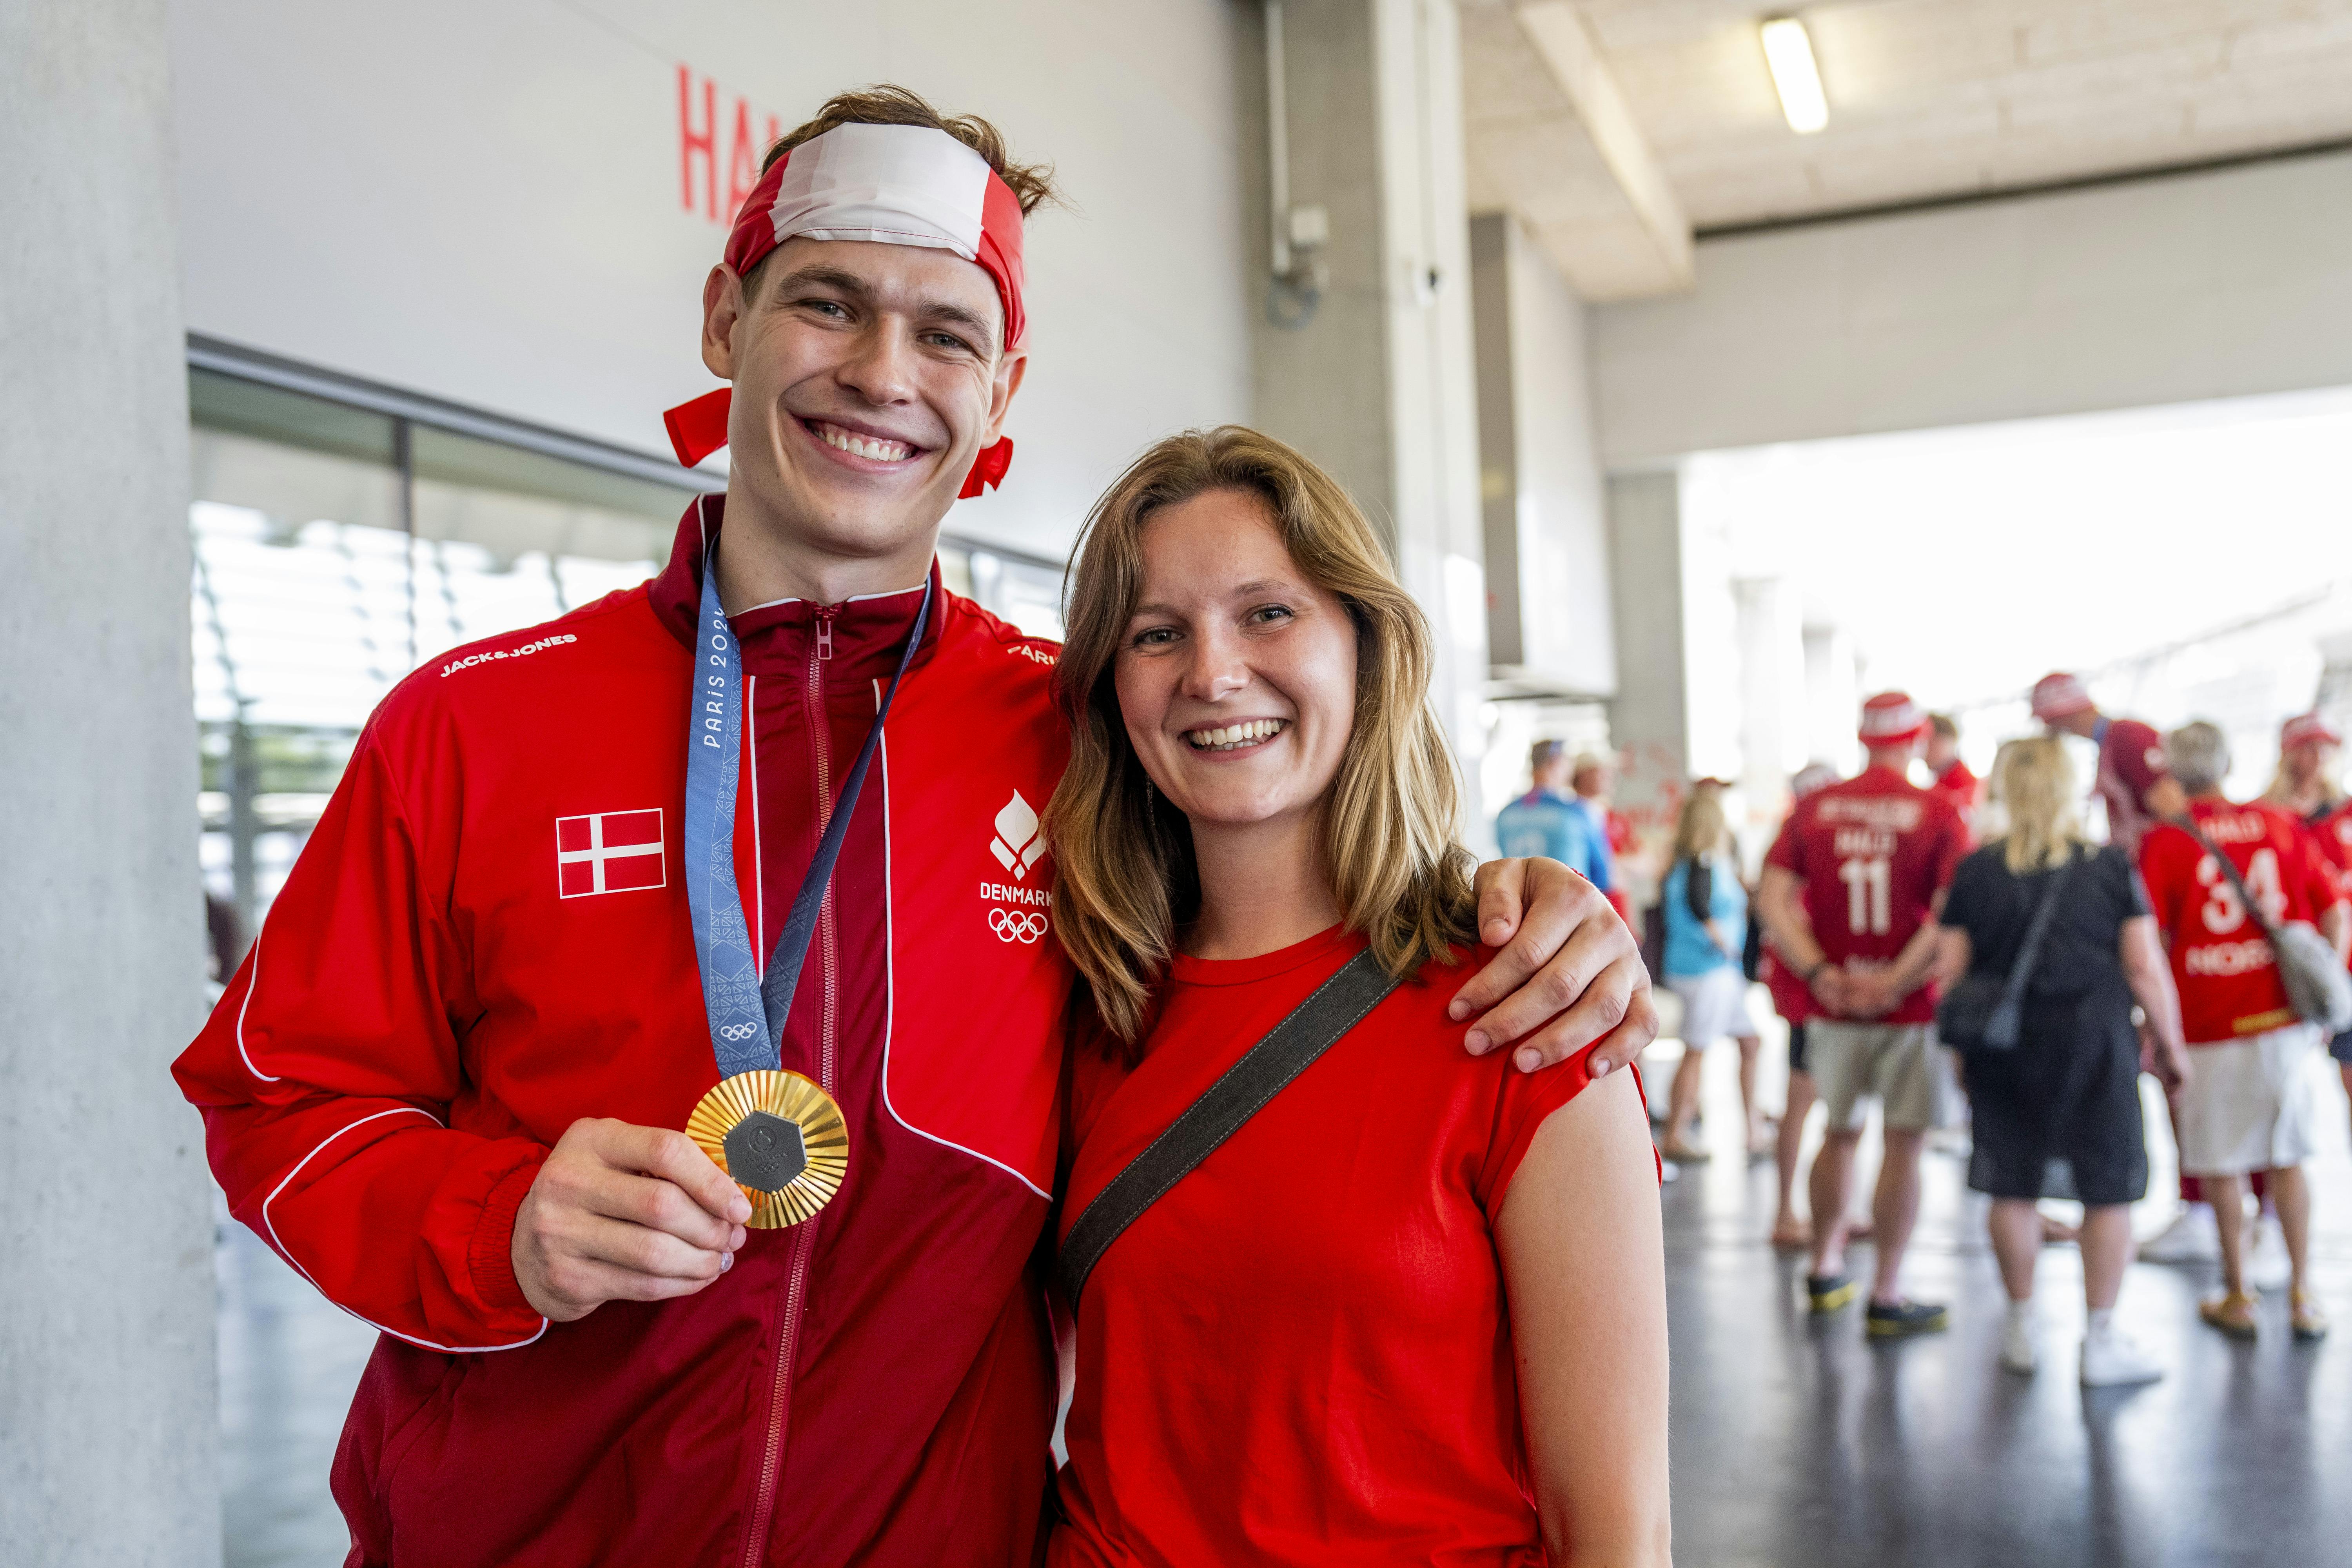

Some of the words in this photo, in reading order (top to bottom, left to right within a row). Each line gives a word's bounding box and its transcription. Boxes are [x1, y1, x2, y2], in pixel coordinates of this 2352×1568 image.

[676, 62, 781, 230] HA
[441, 634, 577, 677] JACK&JONES
[710, 607, 728, 668] 2024
[980, 882, 1053, 907] DENMARK
[1838, 860, 1893, 937] 11
[2196, 848, 2289, 935] 34
